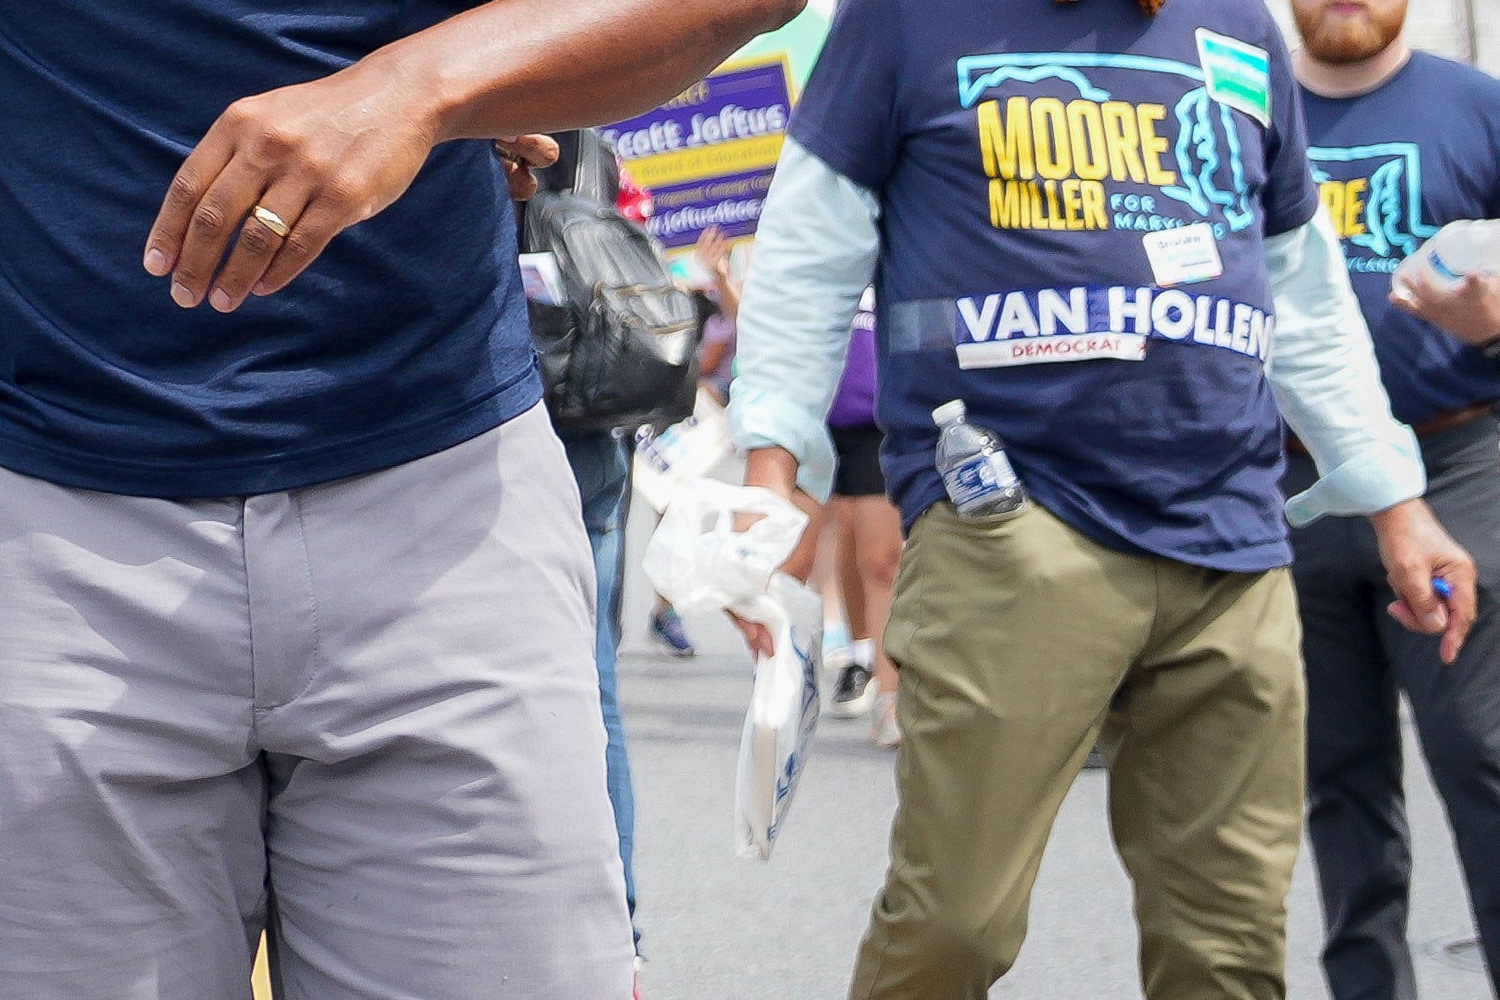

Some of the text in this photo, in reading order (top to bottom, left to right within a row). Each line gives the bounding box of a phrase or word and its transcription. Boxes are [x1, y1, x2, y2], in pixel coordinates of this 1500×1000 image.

[977, 95, 1177, 187] MOORE
[988, 178, 1110, 231] MILLER
[1110, 193, 1156, 213] FOR
[956, 286, 1274, 363] VAN HOLLEN
[1011, 339, 1123, 358] DEMOCRAT
